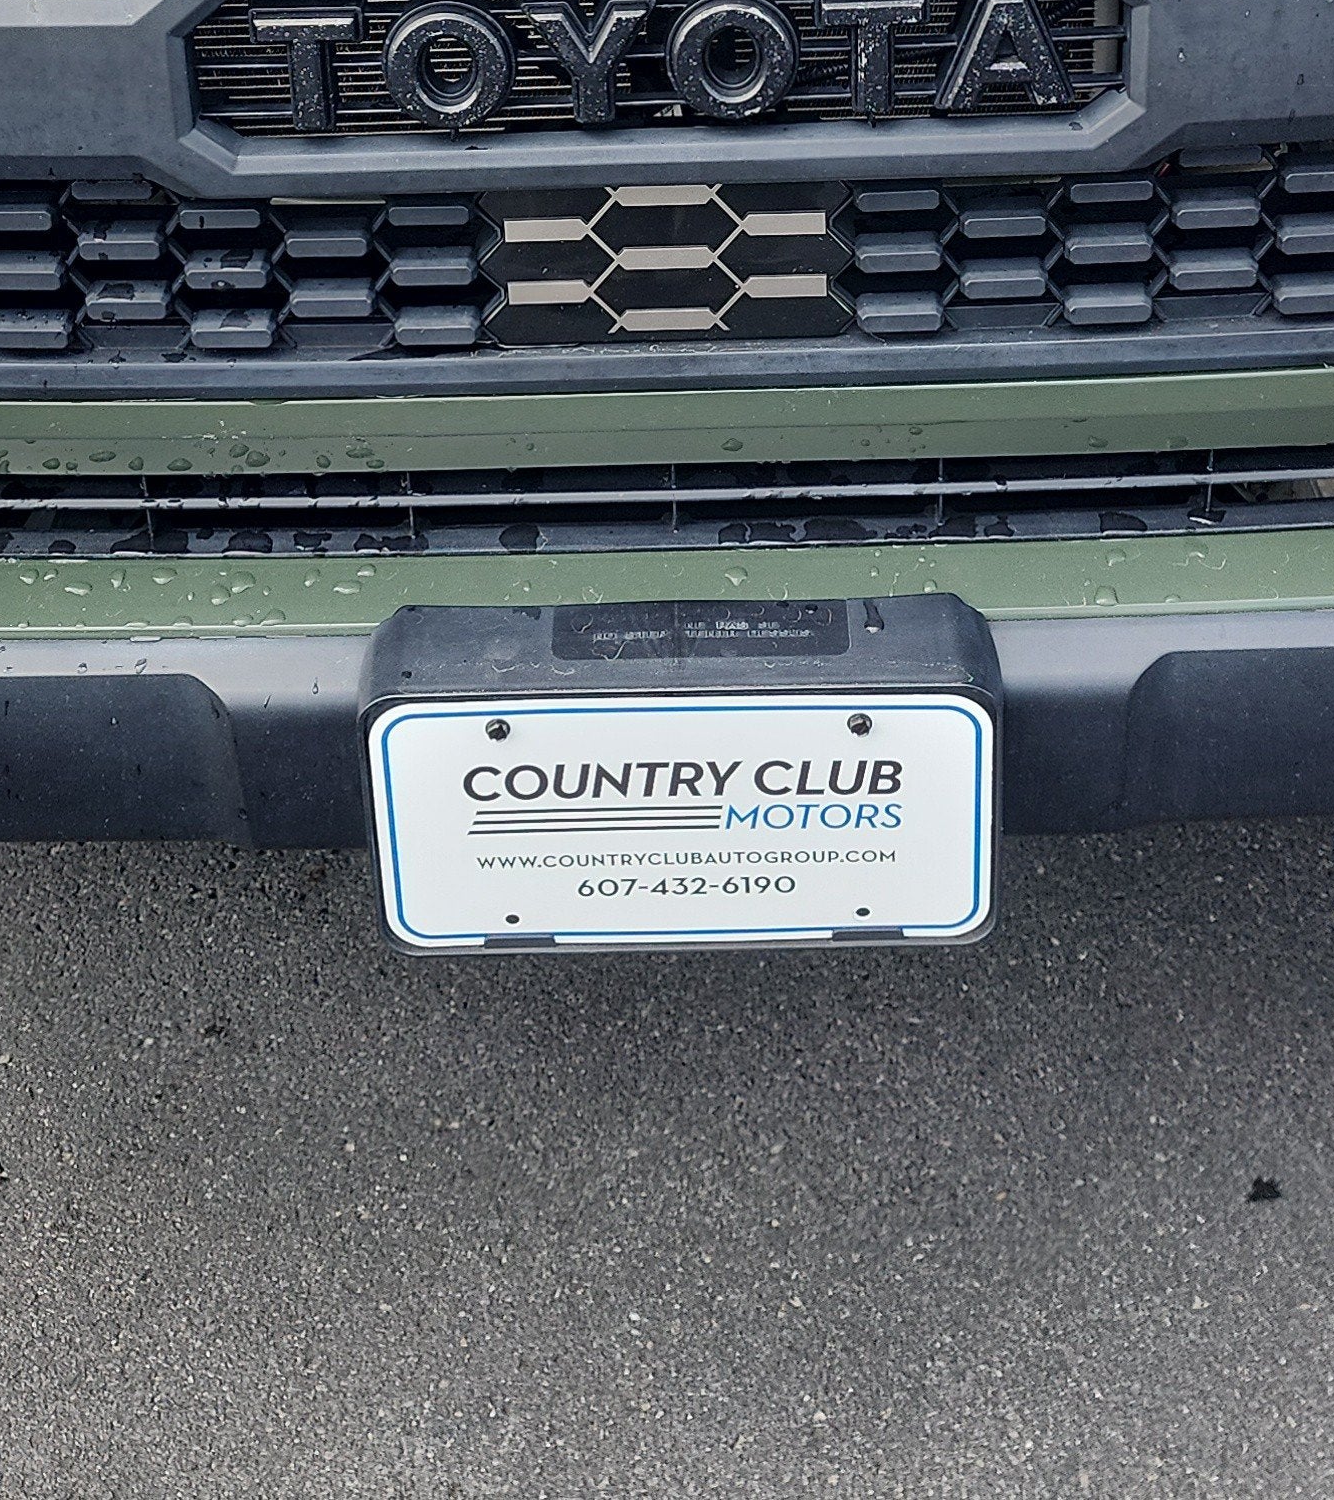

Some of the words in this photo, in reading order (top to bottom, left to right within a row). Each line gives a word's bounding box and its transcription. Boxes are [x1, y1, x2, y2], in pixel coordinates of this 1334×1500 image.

[463, 760, 741, 801] COUNTRY
[753, 759, 903, 796] CLUB
[724, 803, 903, 830] MOTORS
[476, 849, 897, 871] WWW.COUNTRYCLUBAUTOGROUP.COM
[576, 875, 798, 898] 607-432-6190
